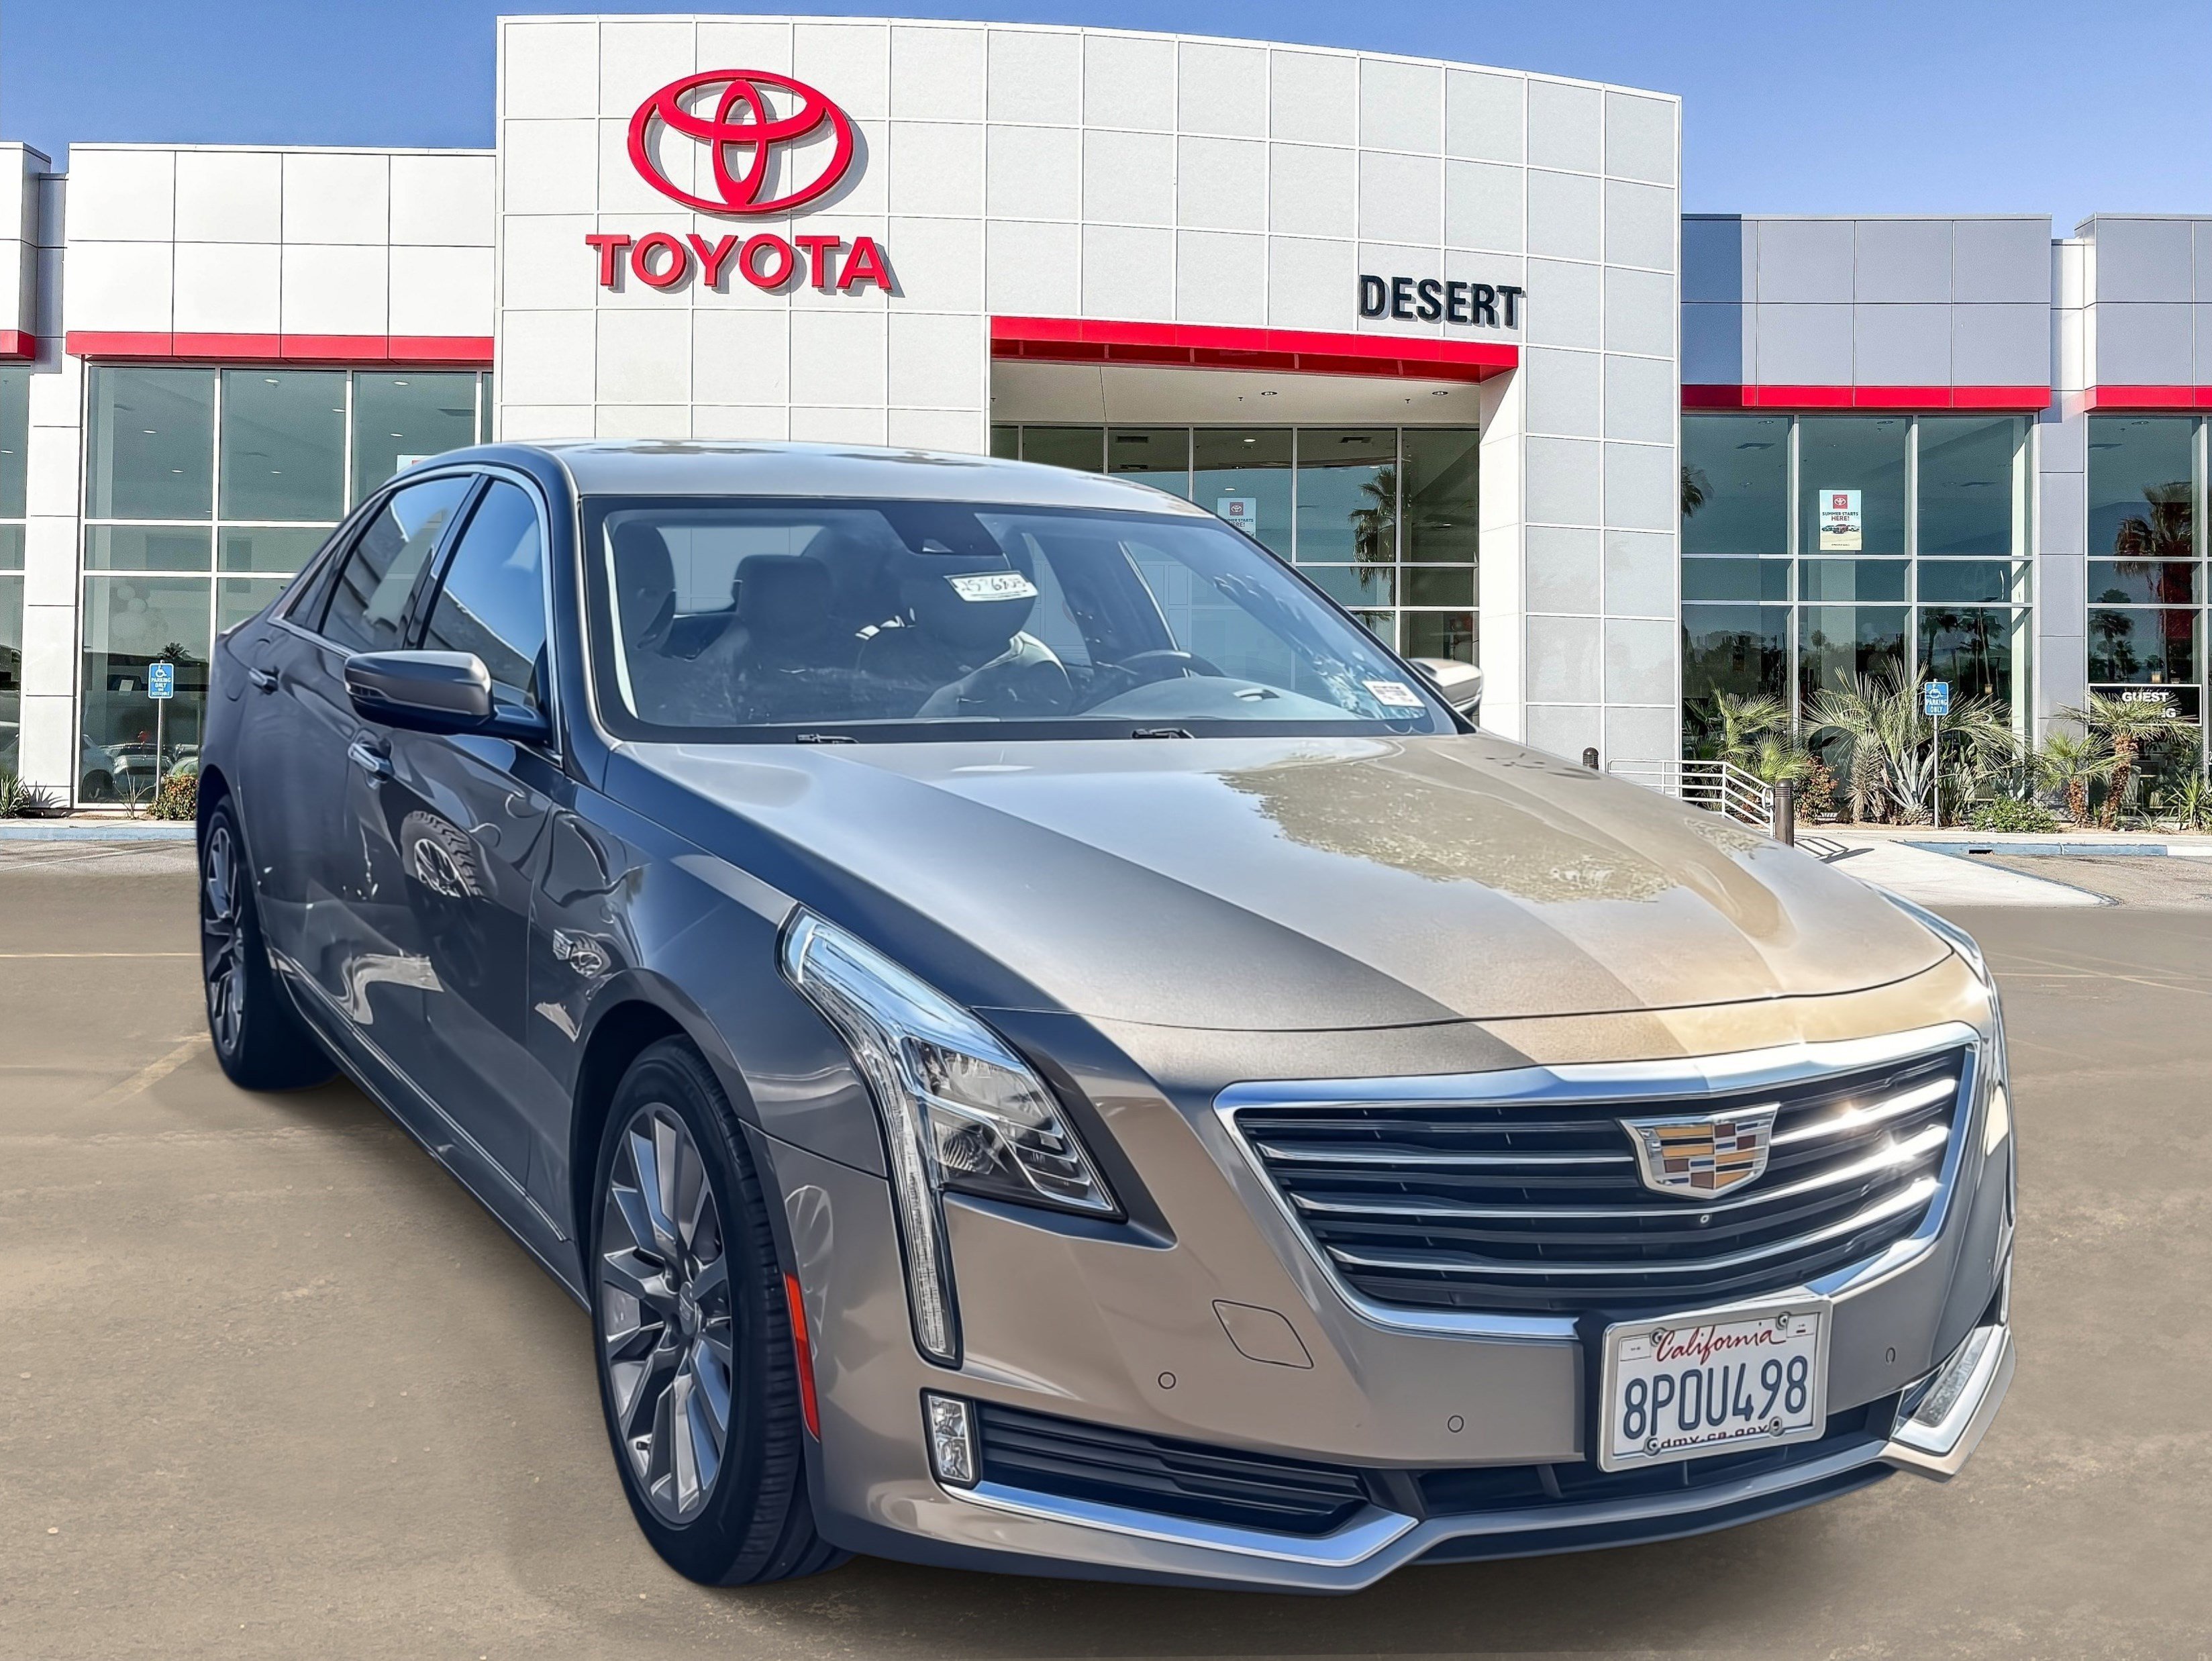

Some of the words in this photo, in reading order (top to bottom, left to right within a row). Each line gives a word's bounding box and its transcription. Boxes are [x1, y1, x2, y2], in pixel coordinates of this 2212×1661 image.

[585, 232, 893, 289] TOYOTA
[1358, 274, 1522, 326] DESERT
[1930, 705, 1944, 713] ONLY
[2121, 692, 2169, 702] GUEST
[1656, 1325, 1787, 1366] California
[1623, 1355, 1809, 1440] 8POU498
